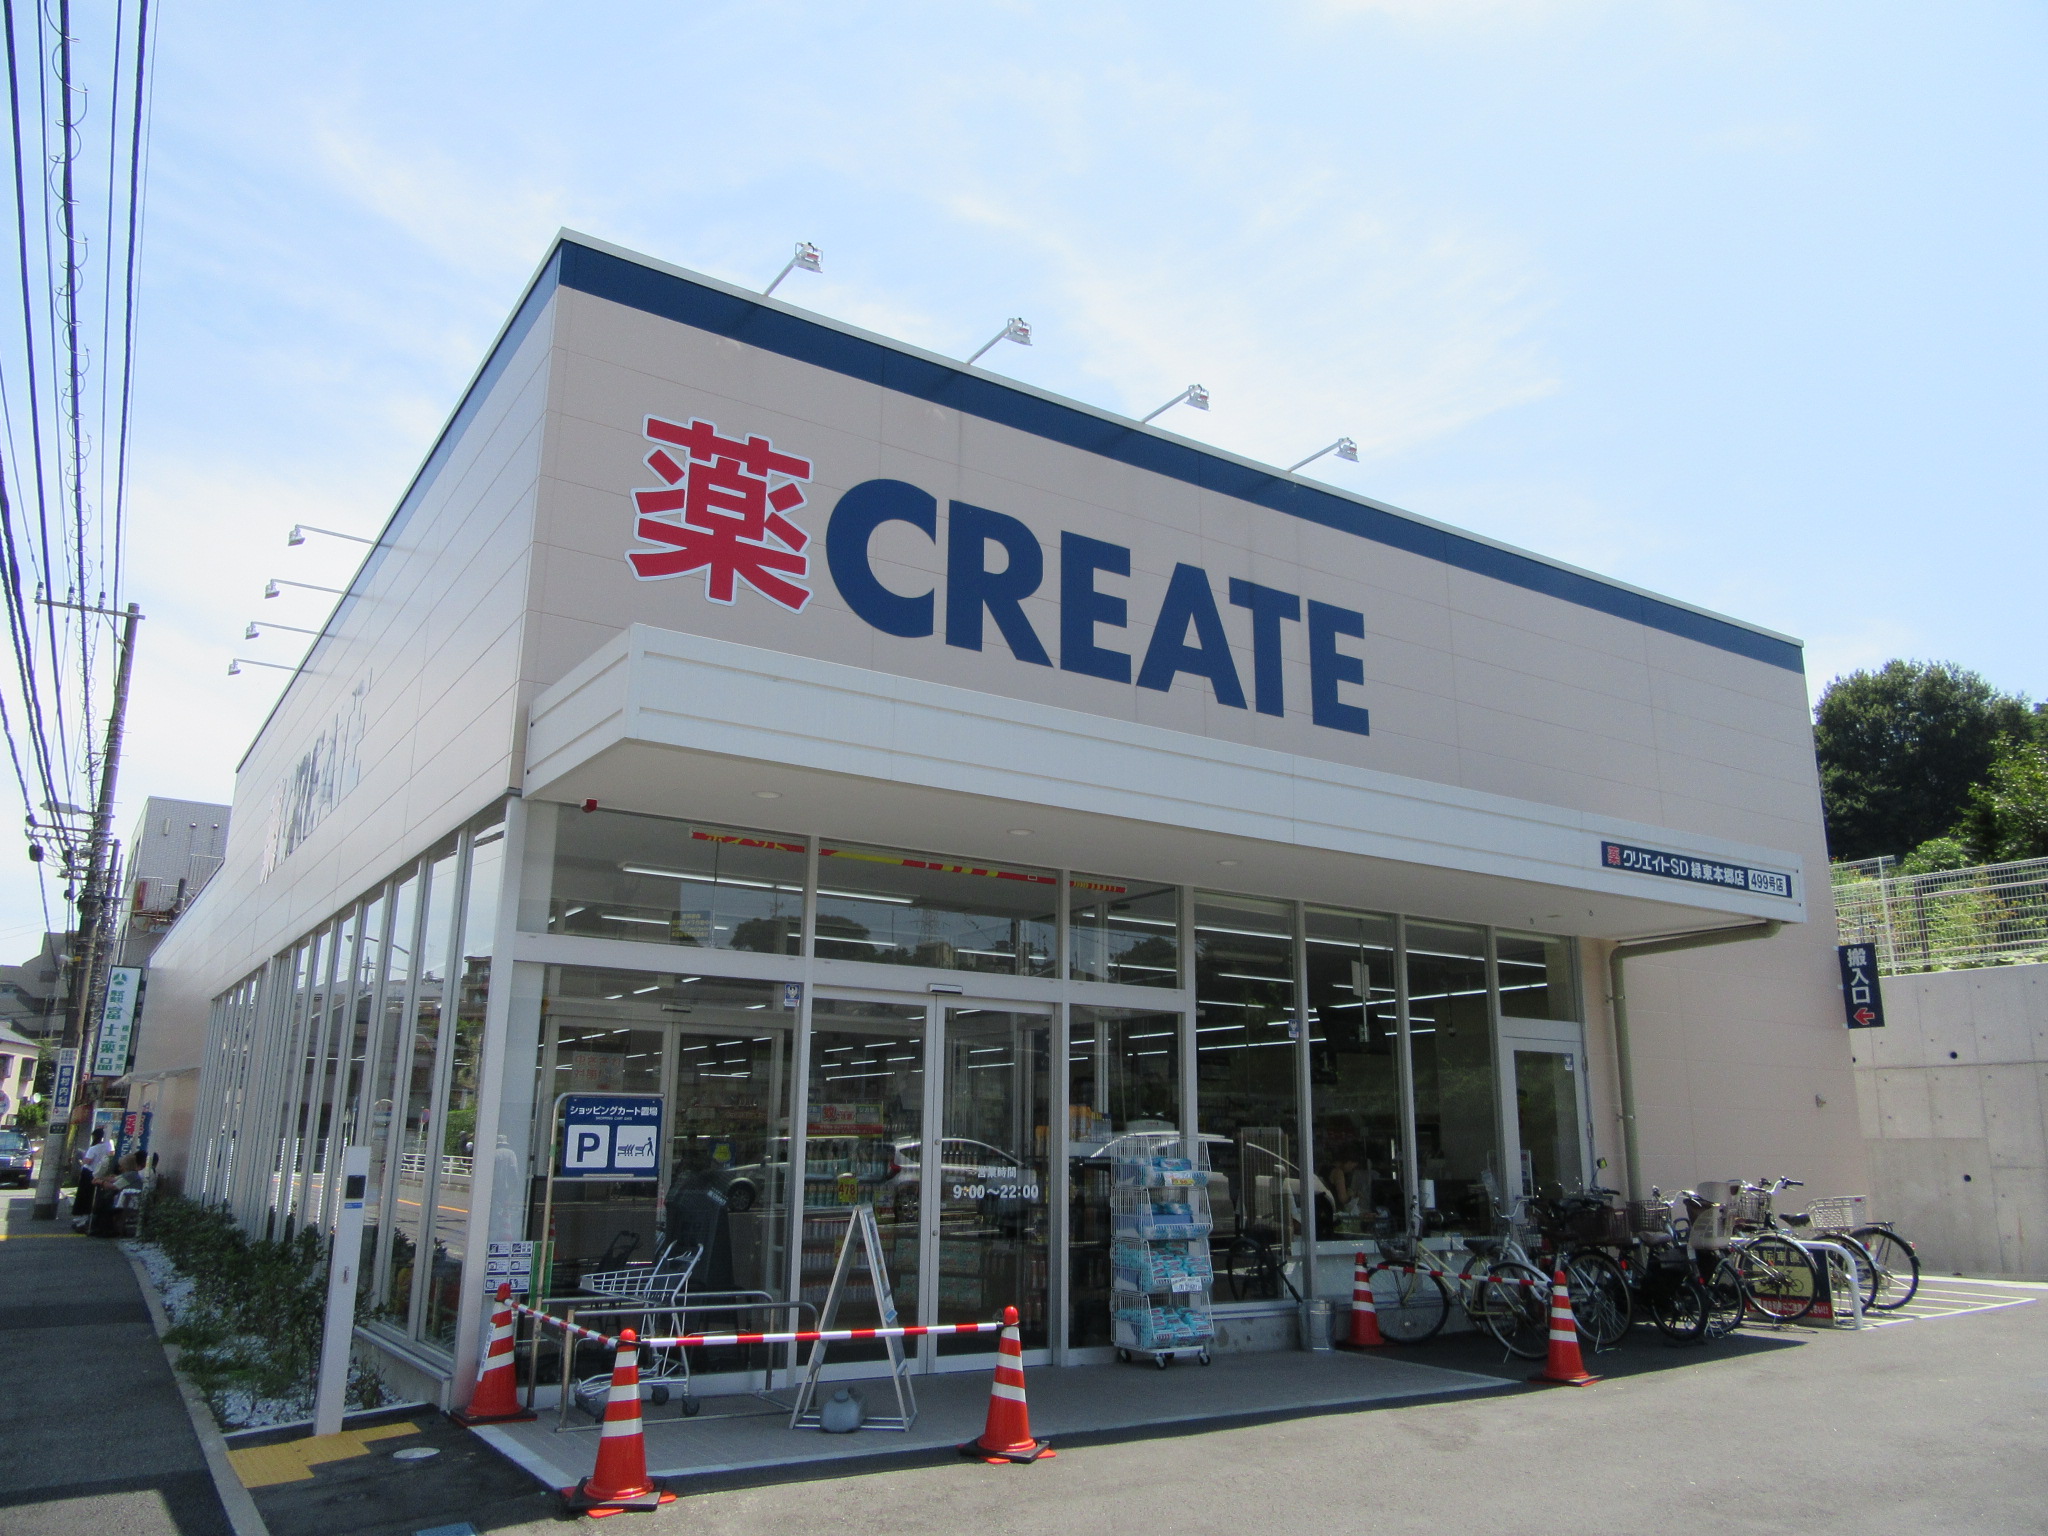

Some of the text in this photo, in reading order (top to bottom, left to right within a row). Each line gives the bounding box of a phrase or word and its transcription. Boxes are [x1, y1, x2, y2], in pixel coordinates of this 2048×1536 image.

[625, 414, 1370, 737] 薬 CREATE
[1607, 845, 1784, 892] 薬 クリエイトSD 緑東本郷店 499号店
[1846, 947, 1871, 1005] 搬入口
[570, 1106, 658, 1117] ショッピングカート置場
[576, 1132, 600, 1162] P
[977, 1166, 1017, 1179] 営業時間
